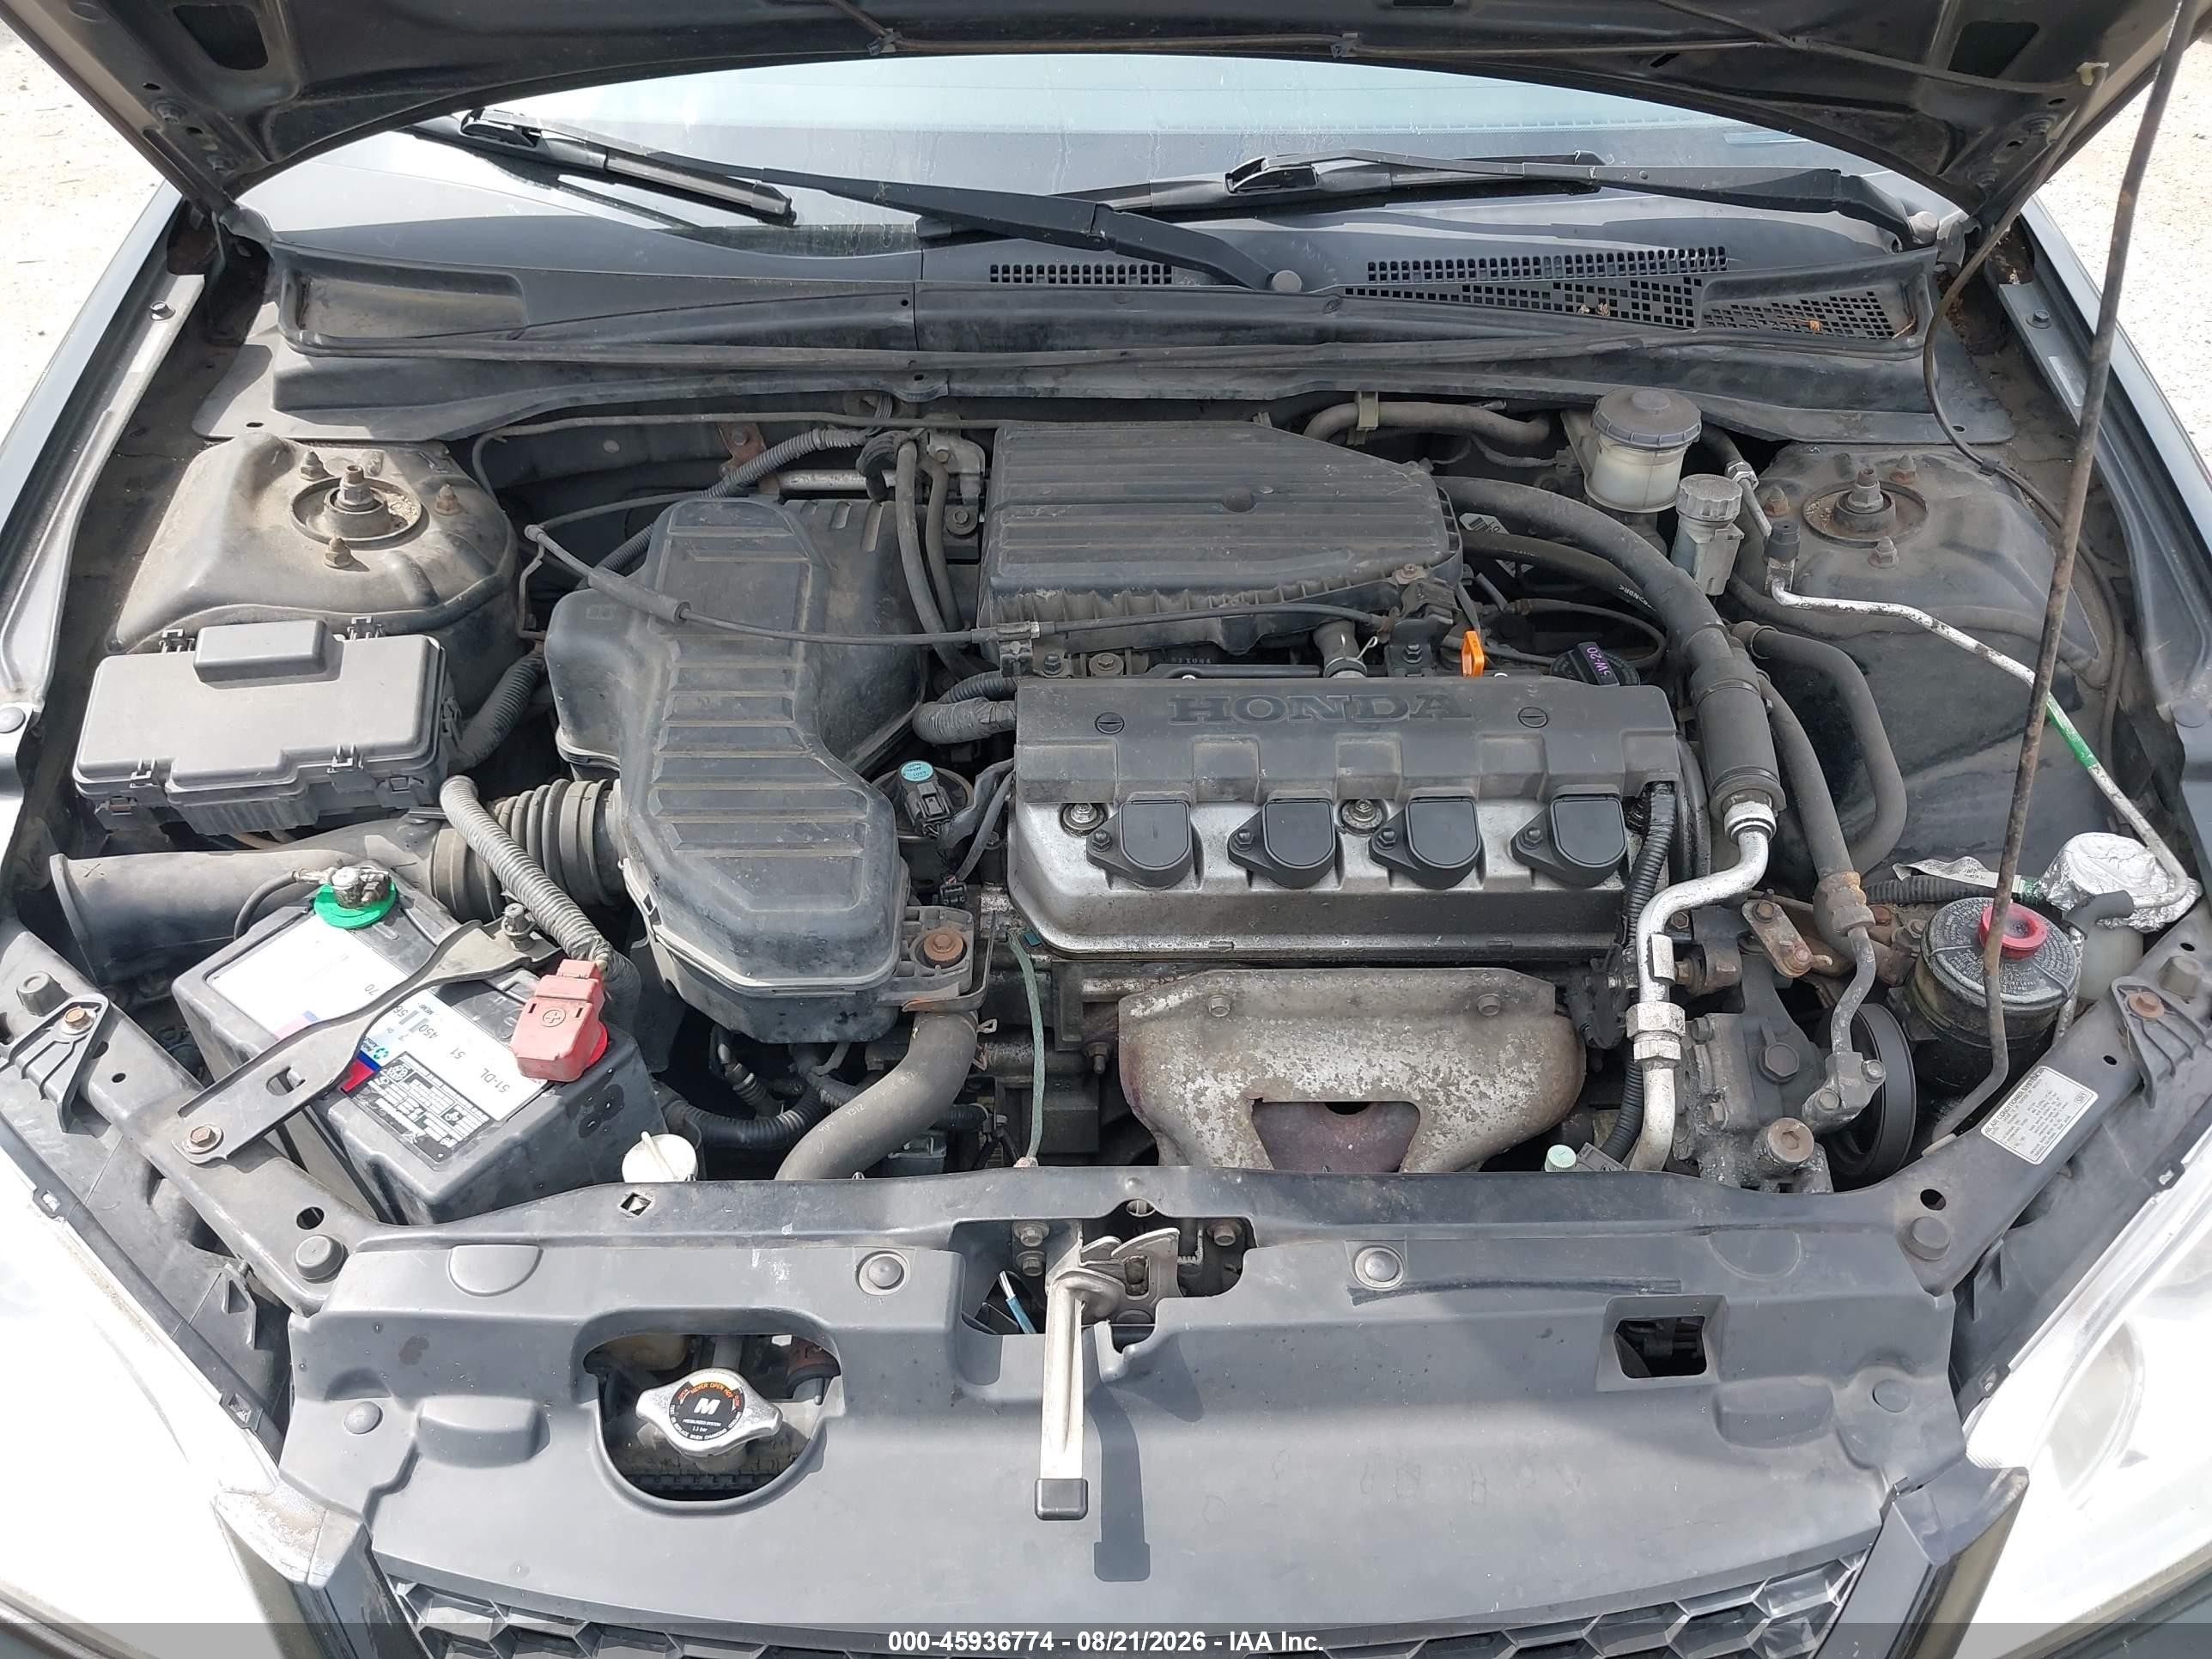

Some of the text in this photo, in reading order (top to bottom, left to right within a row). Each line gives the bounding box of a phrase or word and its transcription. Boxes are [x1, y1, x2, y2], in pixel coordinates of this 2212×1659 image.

[1166, 693, 1473, 725] HONDA
[418, 1024, 439, 1040] 450
[449, 1047, 467, 1060] 51
[480, 1067, 511, 1093] 51-DL
[709, 1382, 725, 1391] OPEN
[694, 1397, 721, 1415] M
